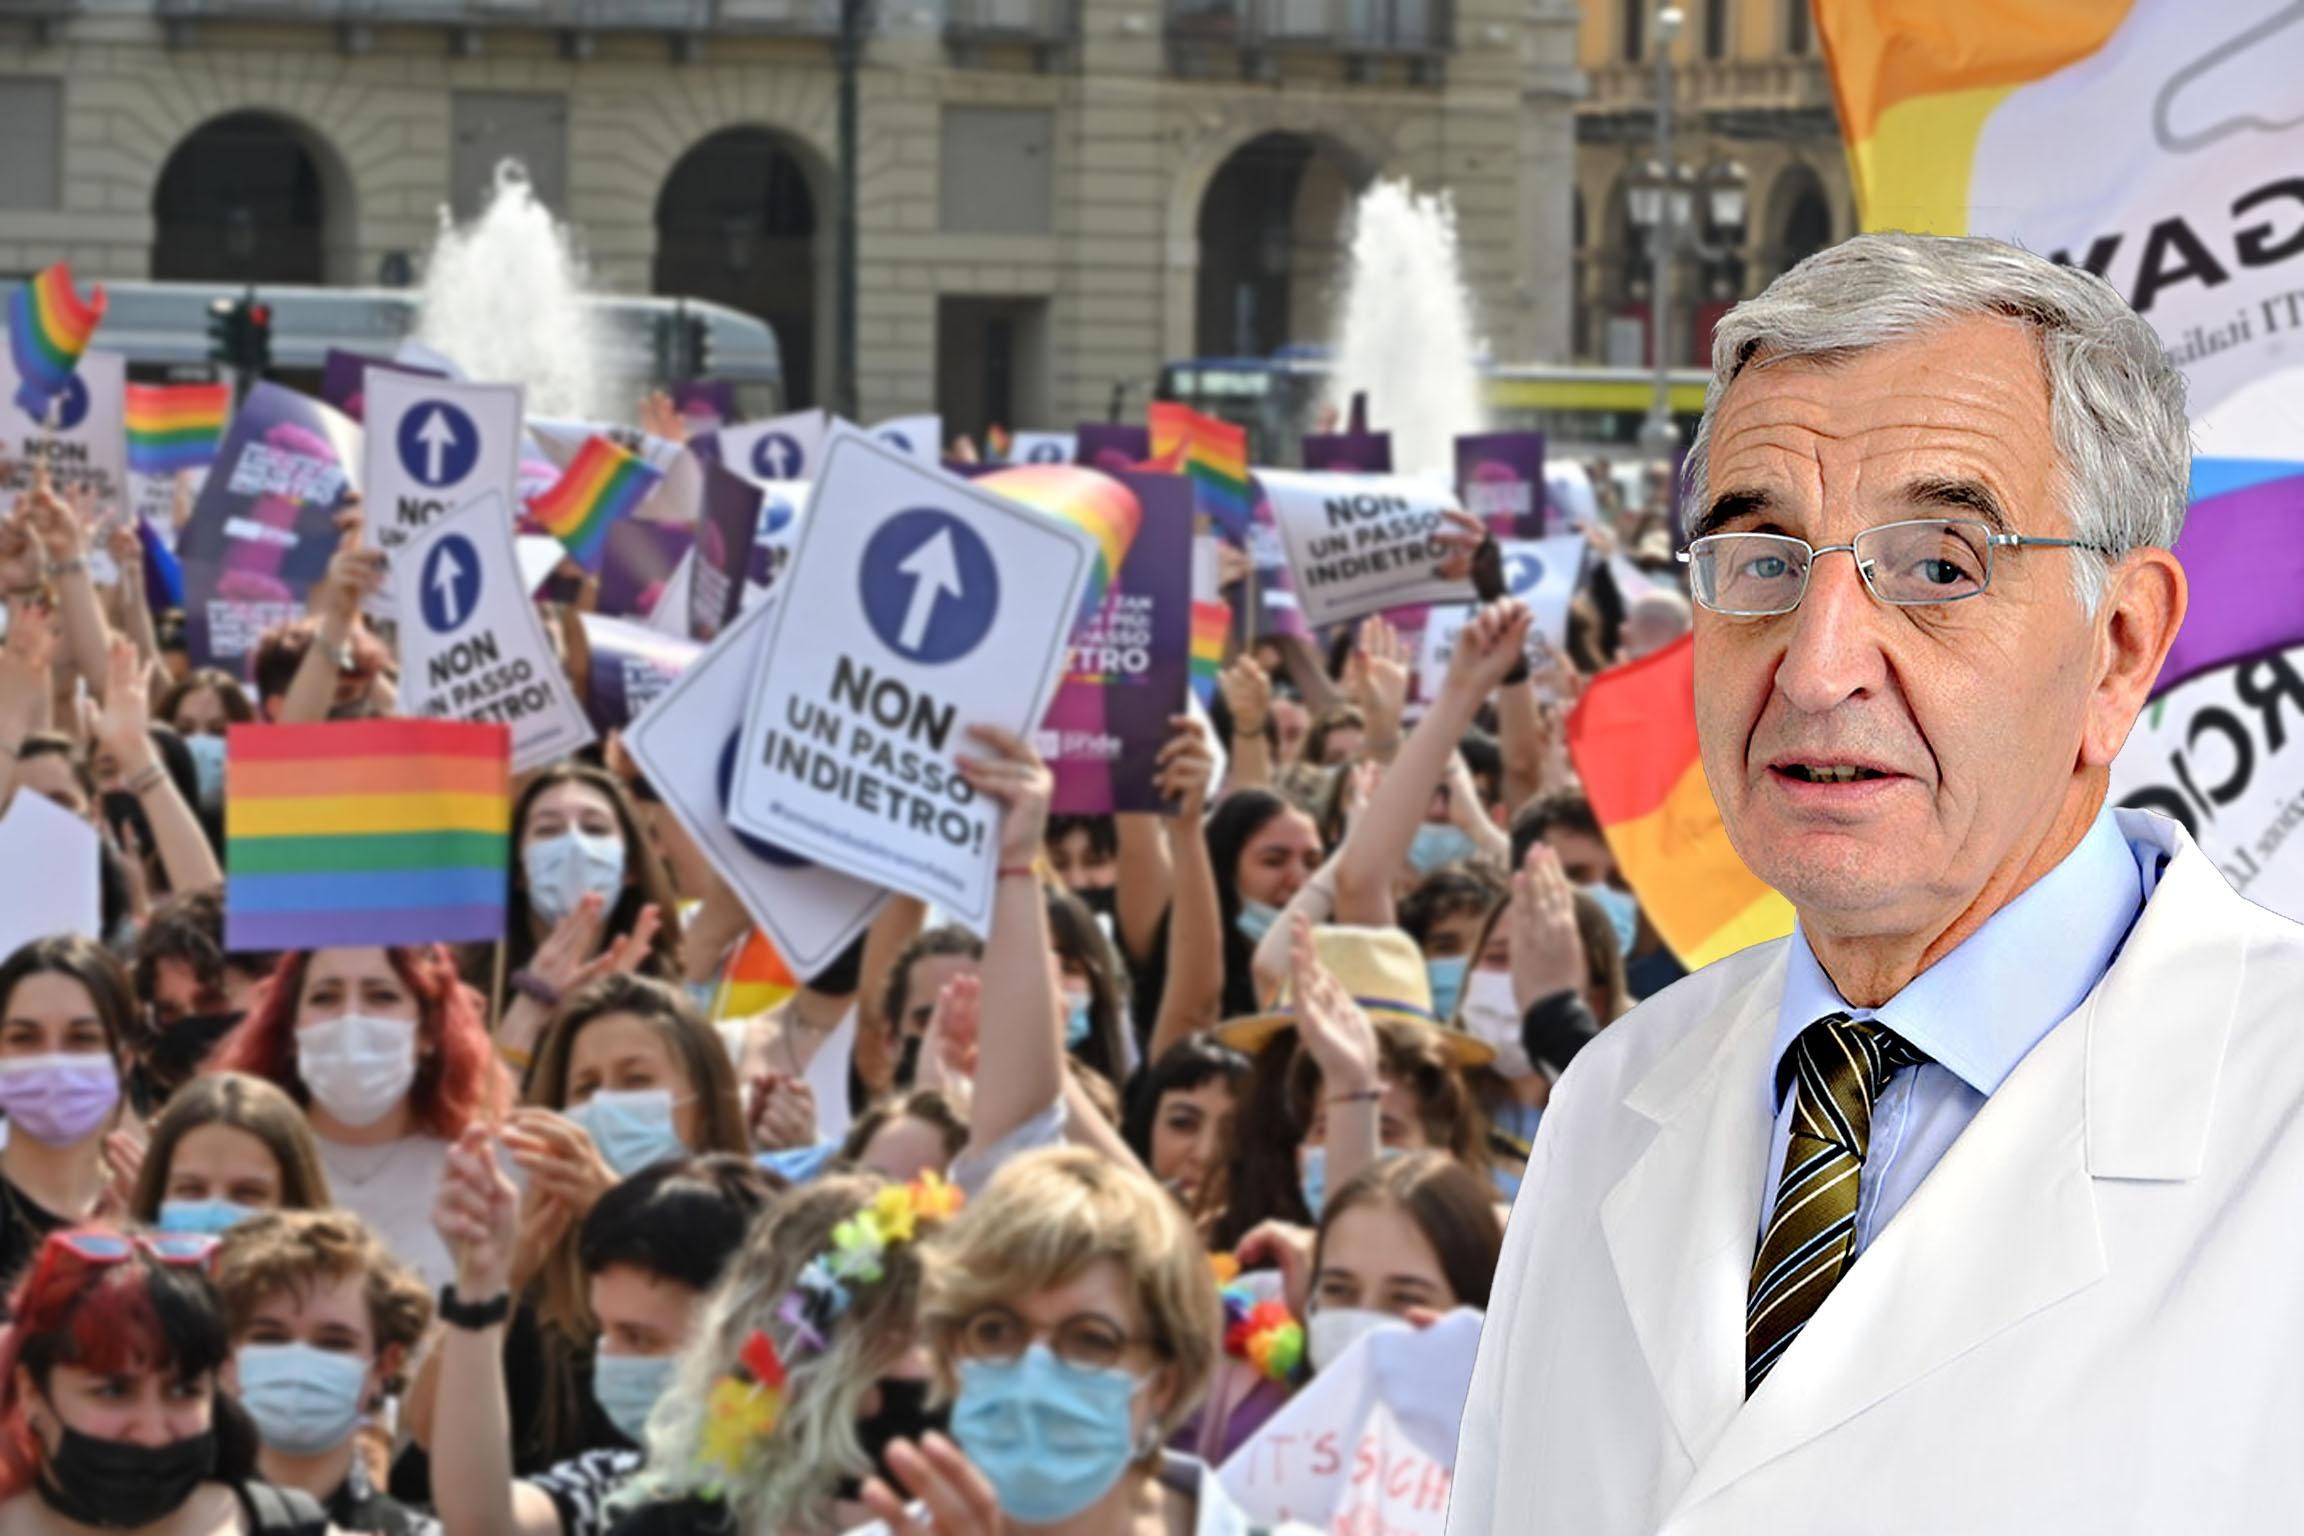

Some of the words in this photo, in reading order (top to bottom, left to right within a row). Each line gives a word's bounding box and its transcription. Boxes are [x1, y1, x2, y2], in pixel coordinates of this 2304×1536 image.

[1308, 533, 1349, 559] UN
[1355, 511, 1442, 547] PASSO
[1323, 493, 1411, 528] NON
[429, 630, 500, 688] NON
[452, 657, 533, 708] PASSO
[829, 654, 957, 752] NON
[786, 694, 841, 747] UN
[849, 726, 976, 805] PASSO
[761, 729, 986, 856] INDIETRO!
